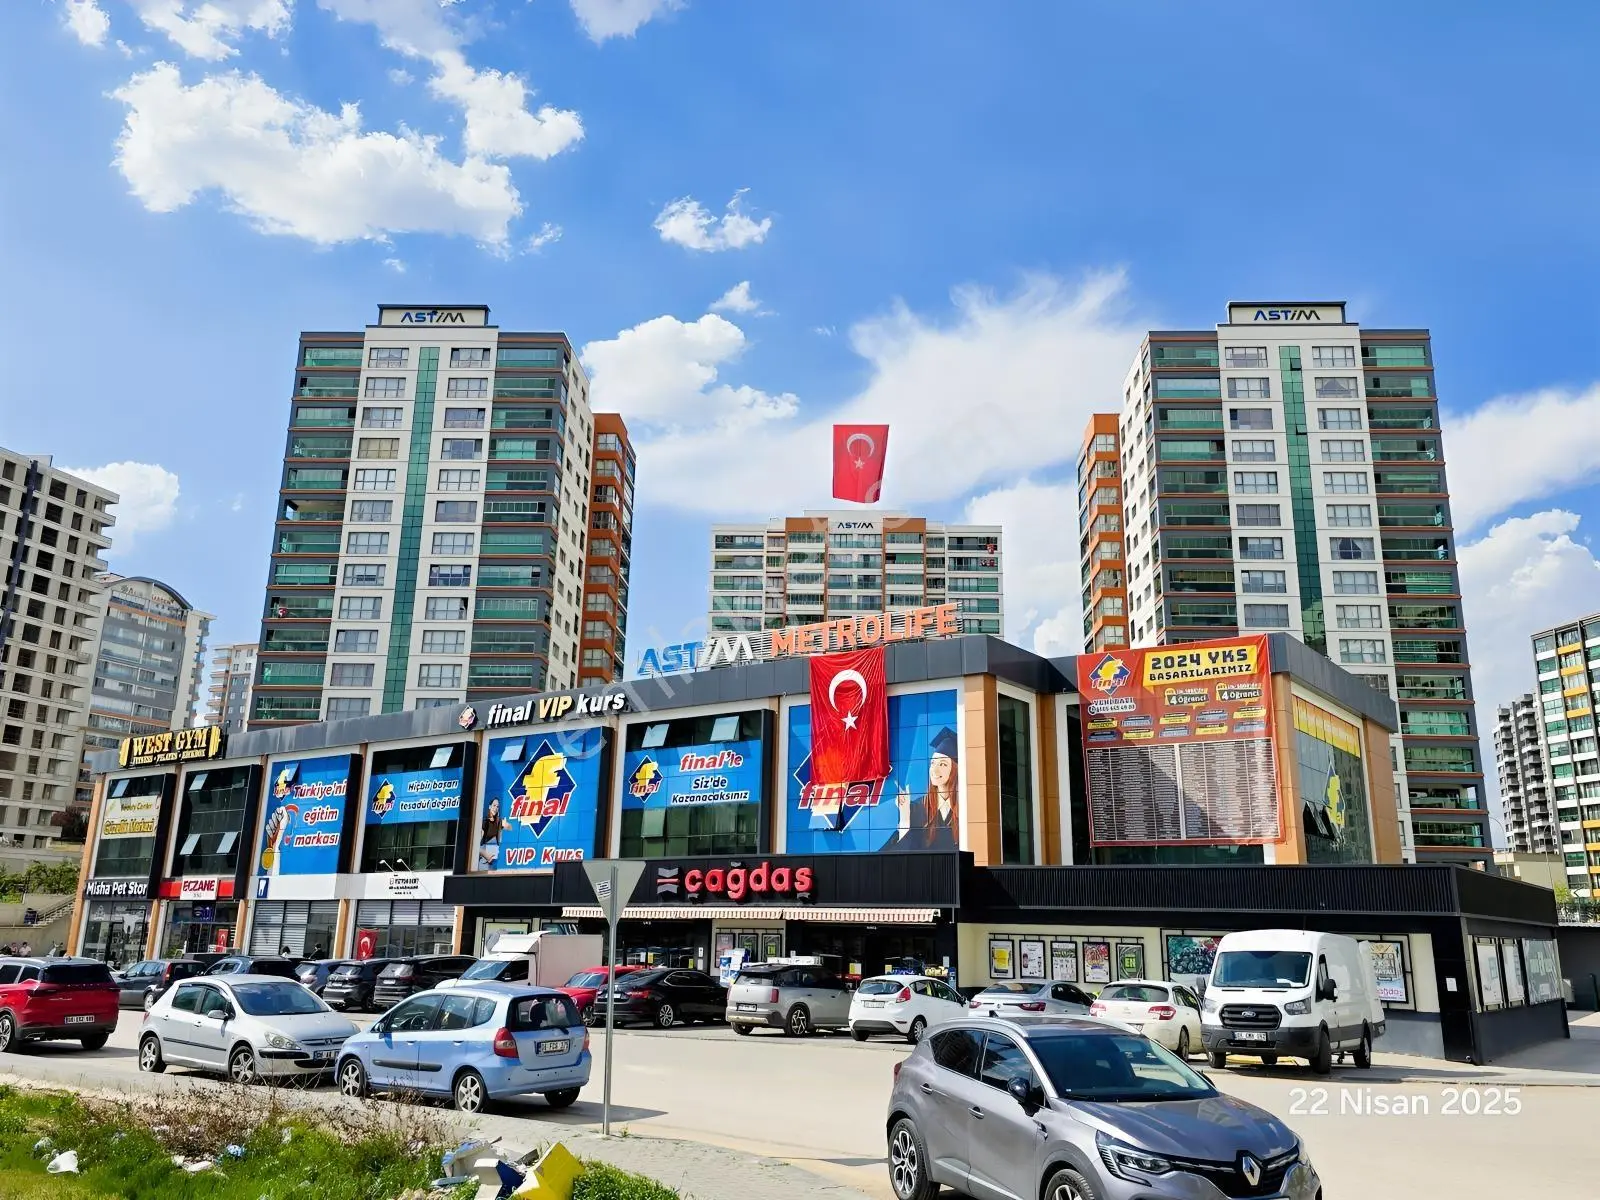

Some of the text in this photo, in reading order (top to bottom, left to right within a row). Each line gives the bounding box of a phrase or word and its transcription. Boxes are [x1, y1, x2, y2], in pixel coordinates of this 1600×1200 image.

[1151, 648, 1248, 670] 2024 YKS
[1170, 696, 1177, 705] 4
[1222, 690, 1229, 700] 4
[487, 693, 626, 725] final VIP kurs
[133, 727, 208, 756] WEST GYM
[294, 779, 348, 799] Türkiye'ni
[628, 781, 661, 795] final
[304, 805, 338, 824] eğitim
[510, 793, 571, 818] final
[294, 831, 339, 846] markası
[506, 847, 535, 865] VIP
[86, 880, 148, 895] Misha Pet Stor
[182, 880, 215, 892] ECZANE
[684, 860, 813, 899] çağdaş
